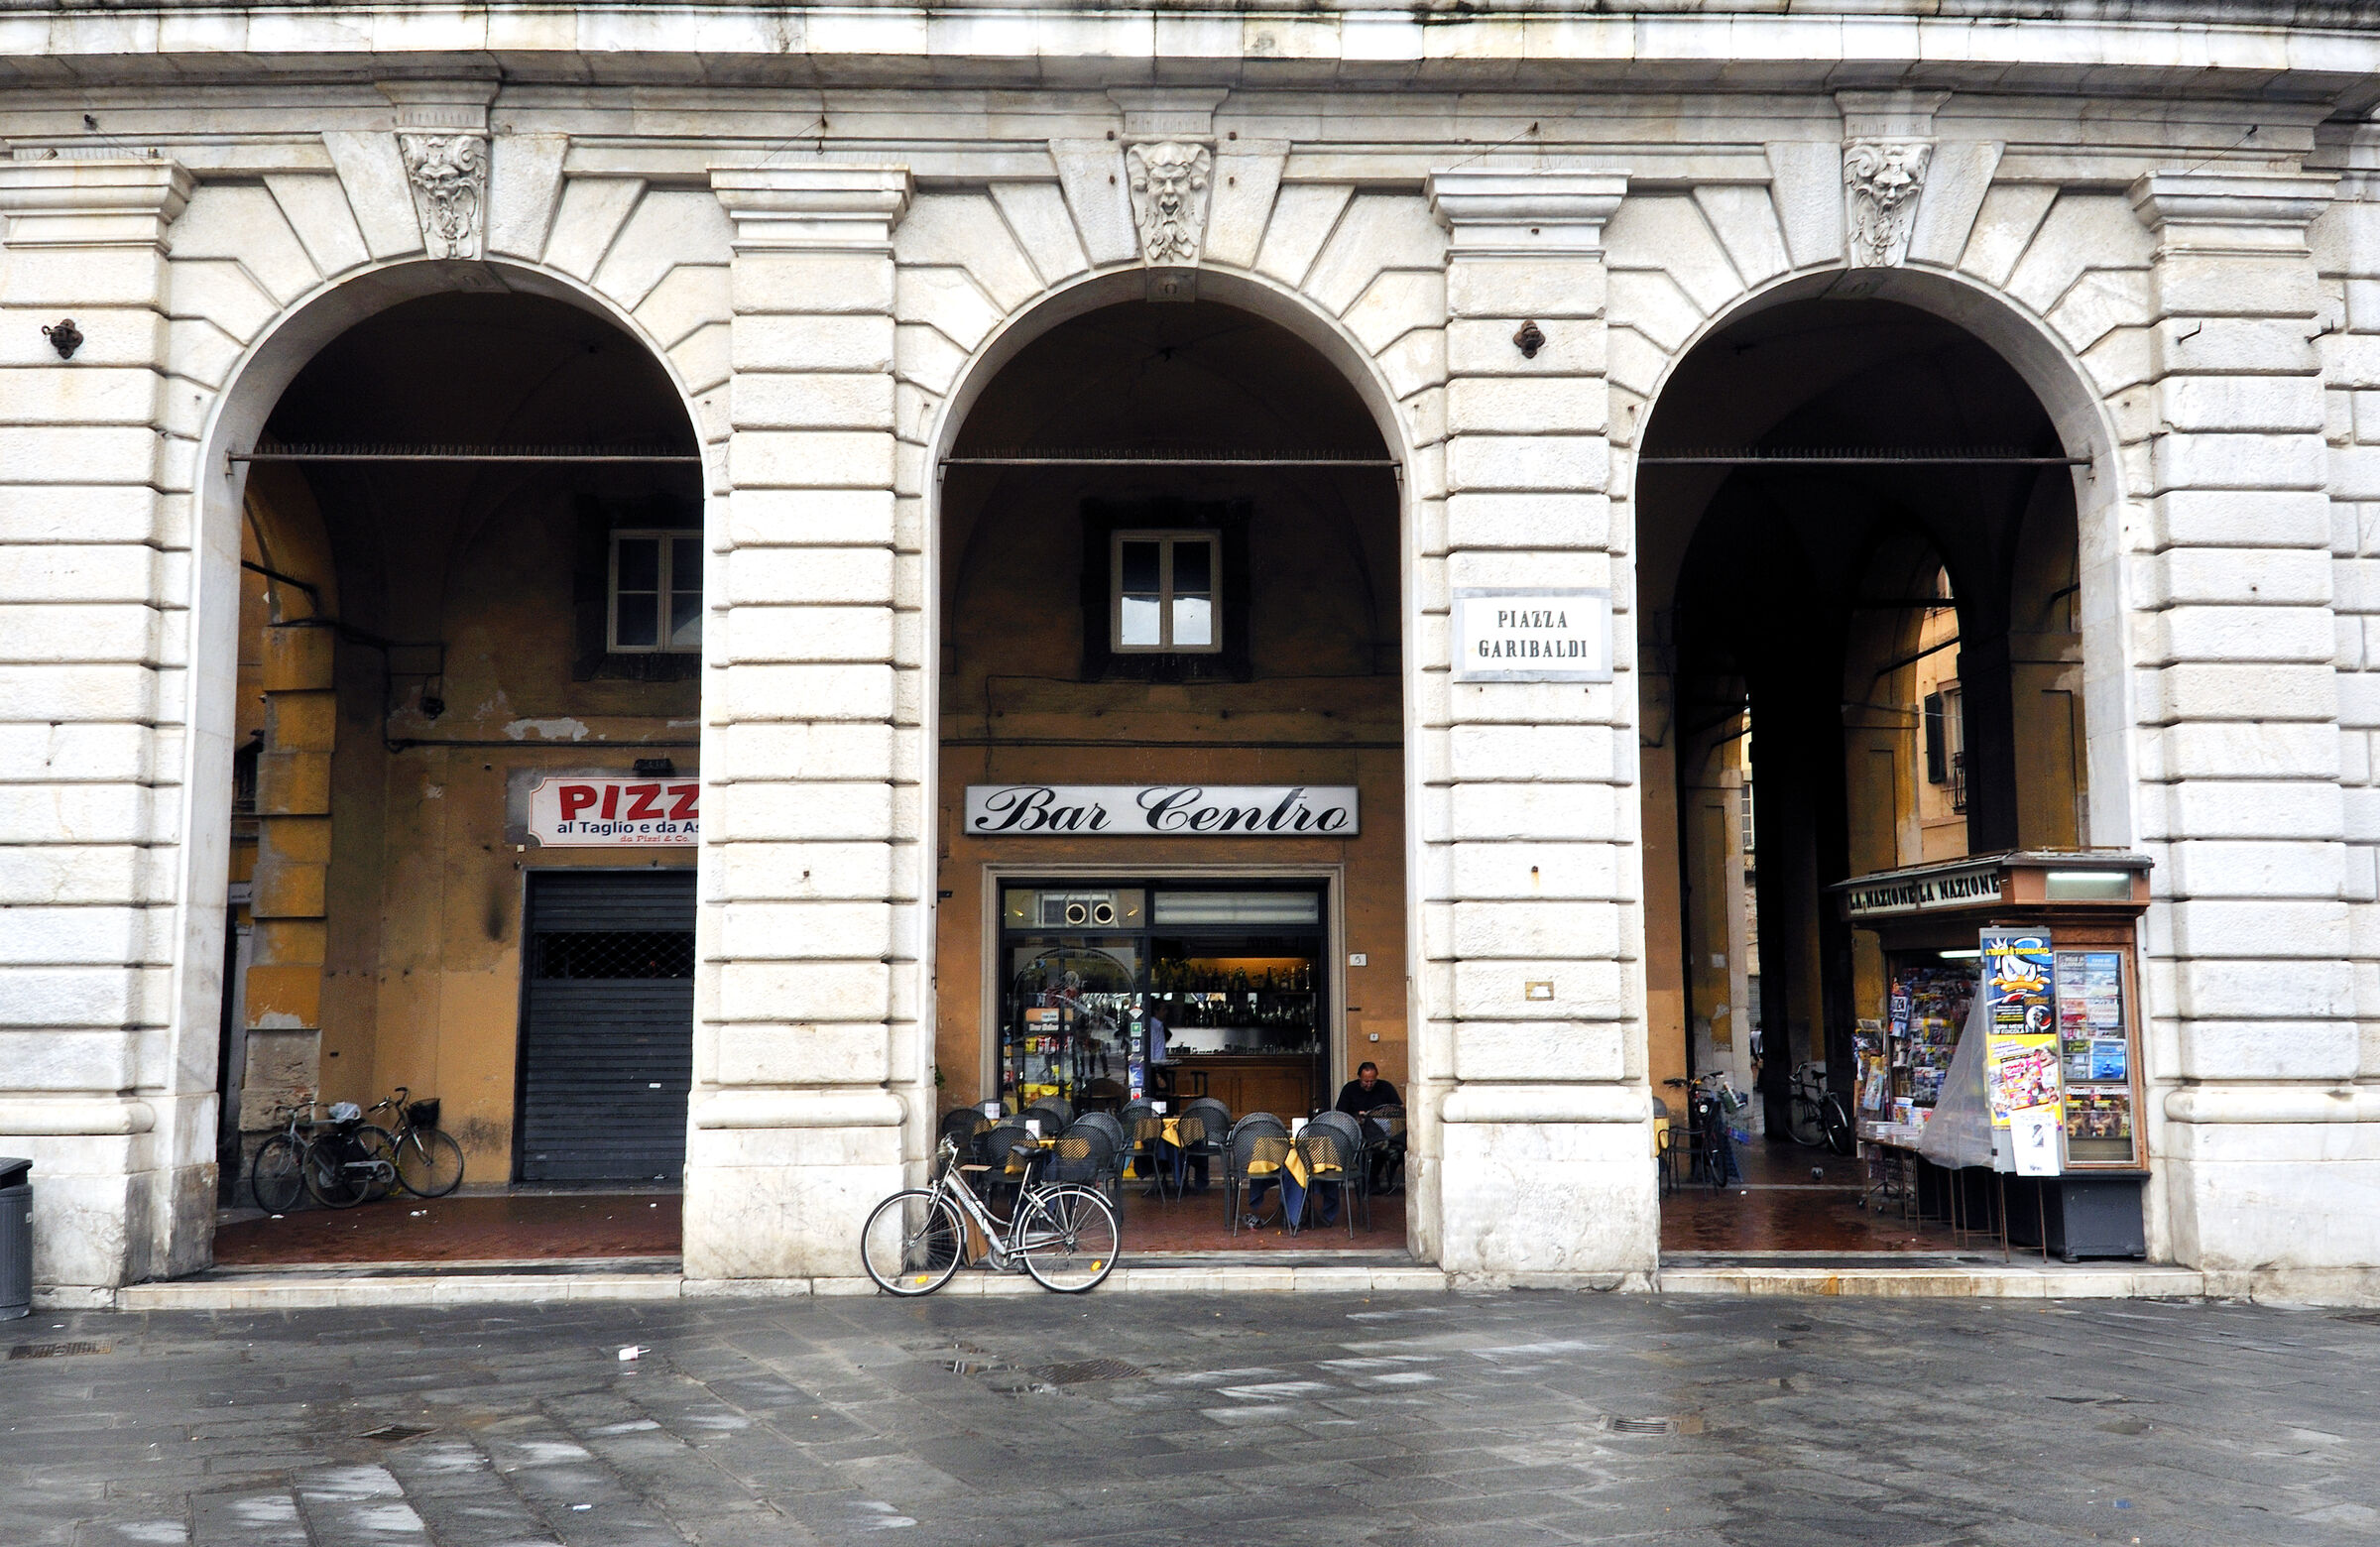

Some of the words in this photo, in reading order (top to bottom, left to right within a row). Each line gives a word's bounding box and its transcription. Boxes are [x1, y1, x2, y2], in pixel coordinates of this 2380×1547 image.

[1498, 611, 1568, 628] PIAZZA
[1479, 640, 1587, 658] GARIBALDI
[975, 786, 1115, 832] Bar
[1136, 787, 1350, 832] Centro
[557, 821, 572, 833] al
[579, 821, 635, 836] Taglio
[640, 824, 651, 833] e
[655, 821, 677, 833] da
[1864, 886, 1917, 909] NAZIONE
[1918, 883, 1936, 903] LA
[1939, 873, 1999, 900] NAZIONE
